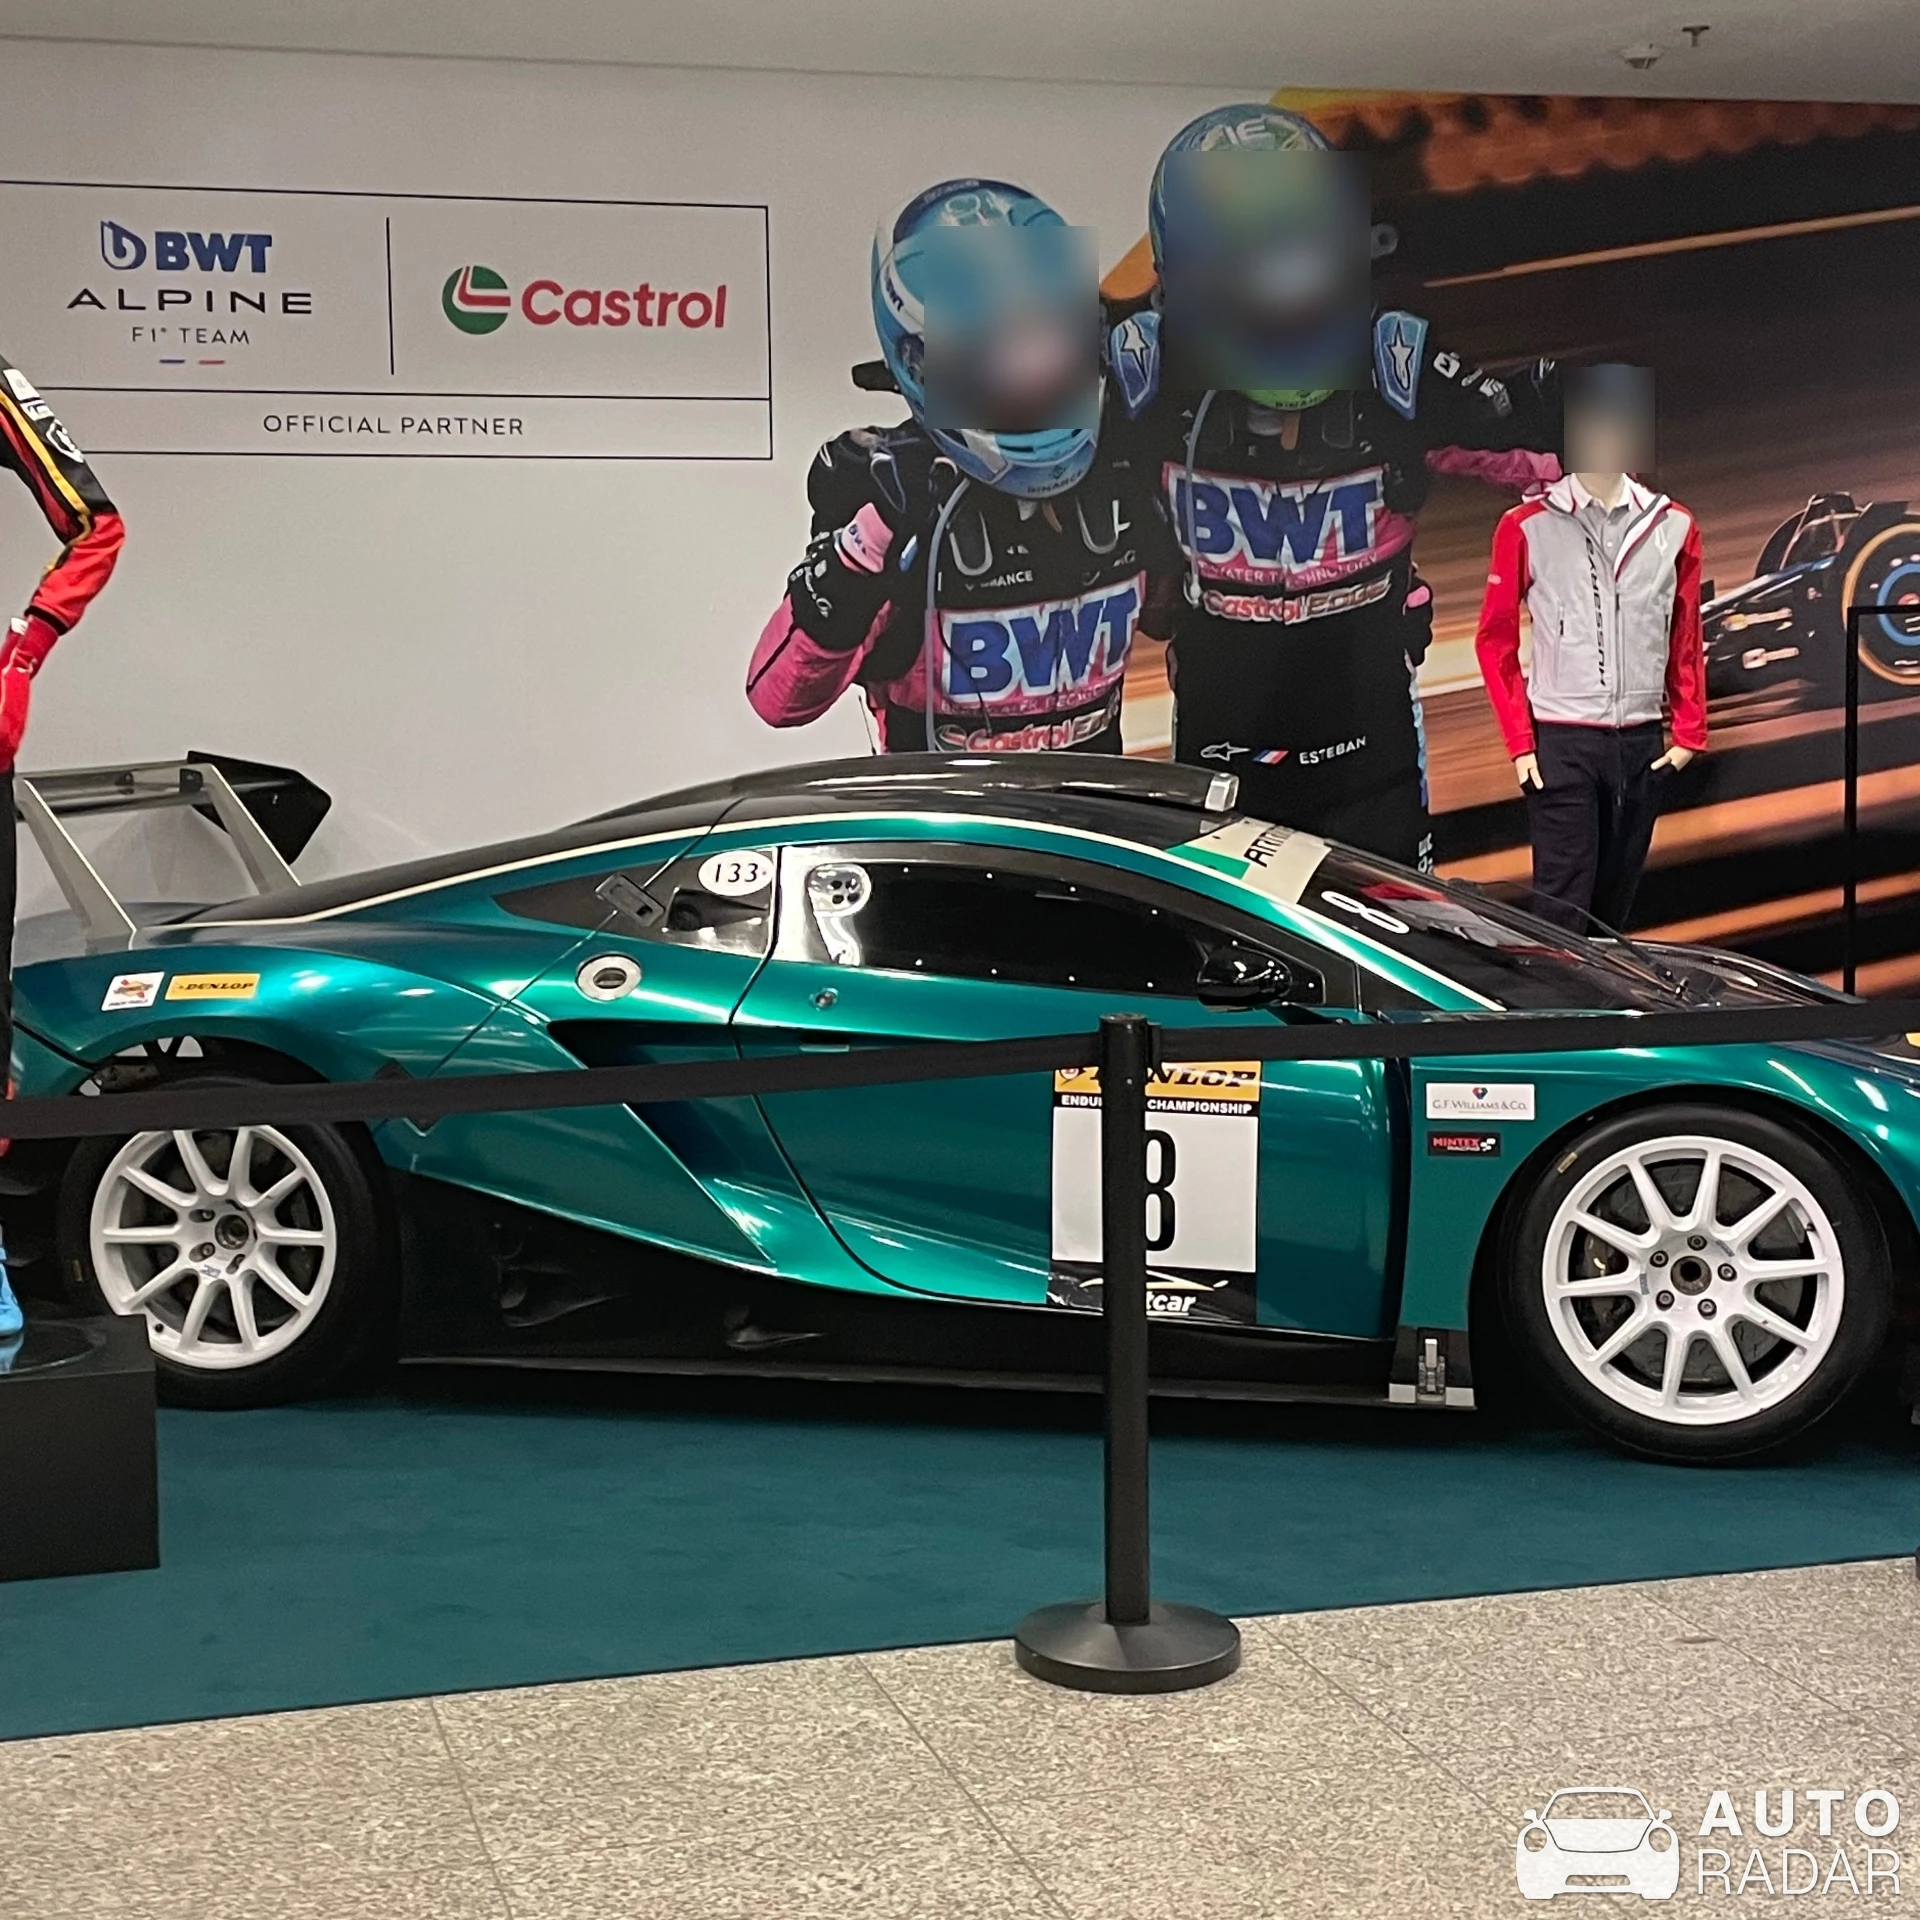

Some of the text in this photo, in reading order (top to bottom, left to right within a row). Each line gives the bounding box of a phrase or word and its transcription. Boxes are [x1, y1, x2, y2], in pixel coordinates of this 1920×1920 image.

[155, 231, 272, 273] BWT
[66, 288, 312, 315] ALPINE
[521, 279, 727, 329] Castrol
[179, 328, 249, 345] TEAM
[263, 415, 523, 437] OFFICIAL PARTNER
[1176, 478, 1381, 566] BWT
[1203, 589, 1306, 626] Castrol
[947, 586, 1138, 696] BWT
[966, 719, 1072, 752] Castrol
[1300, 735, 1367, 765] ESTEBAN
[714, 862, 760, 884] 133
[1320, 890, 1410, 935] 8
[1147, 1099, 1253, 1115] CHAMPIONSHIP
